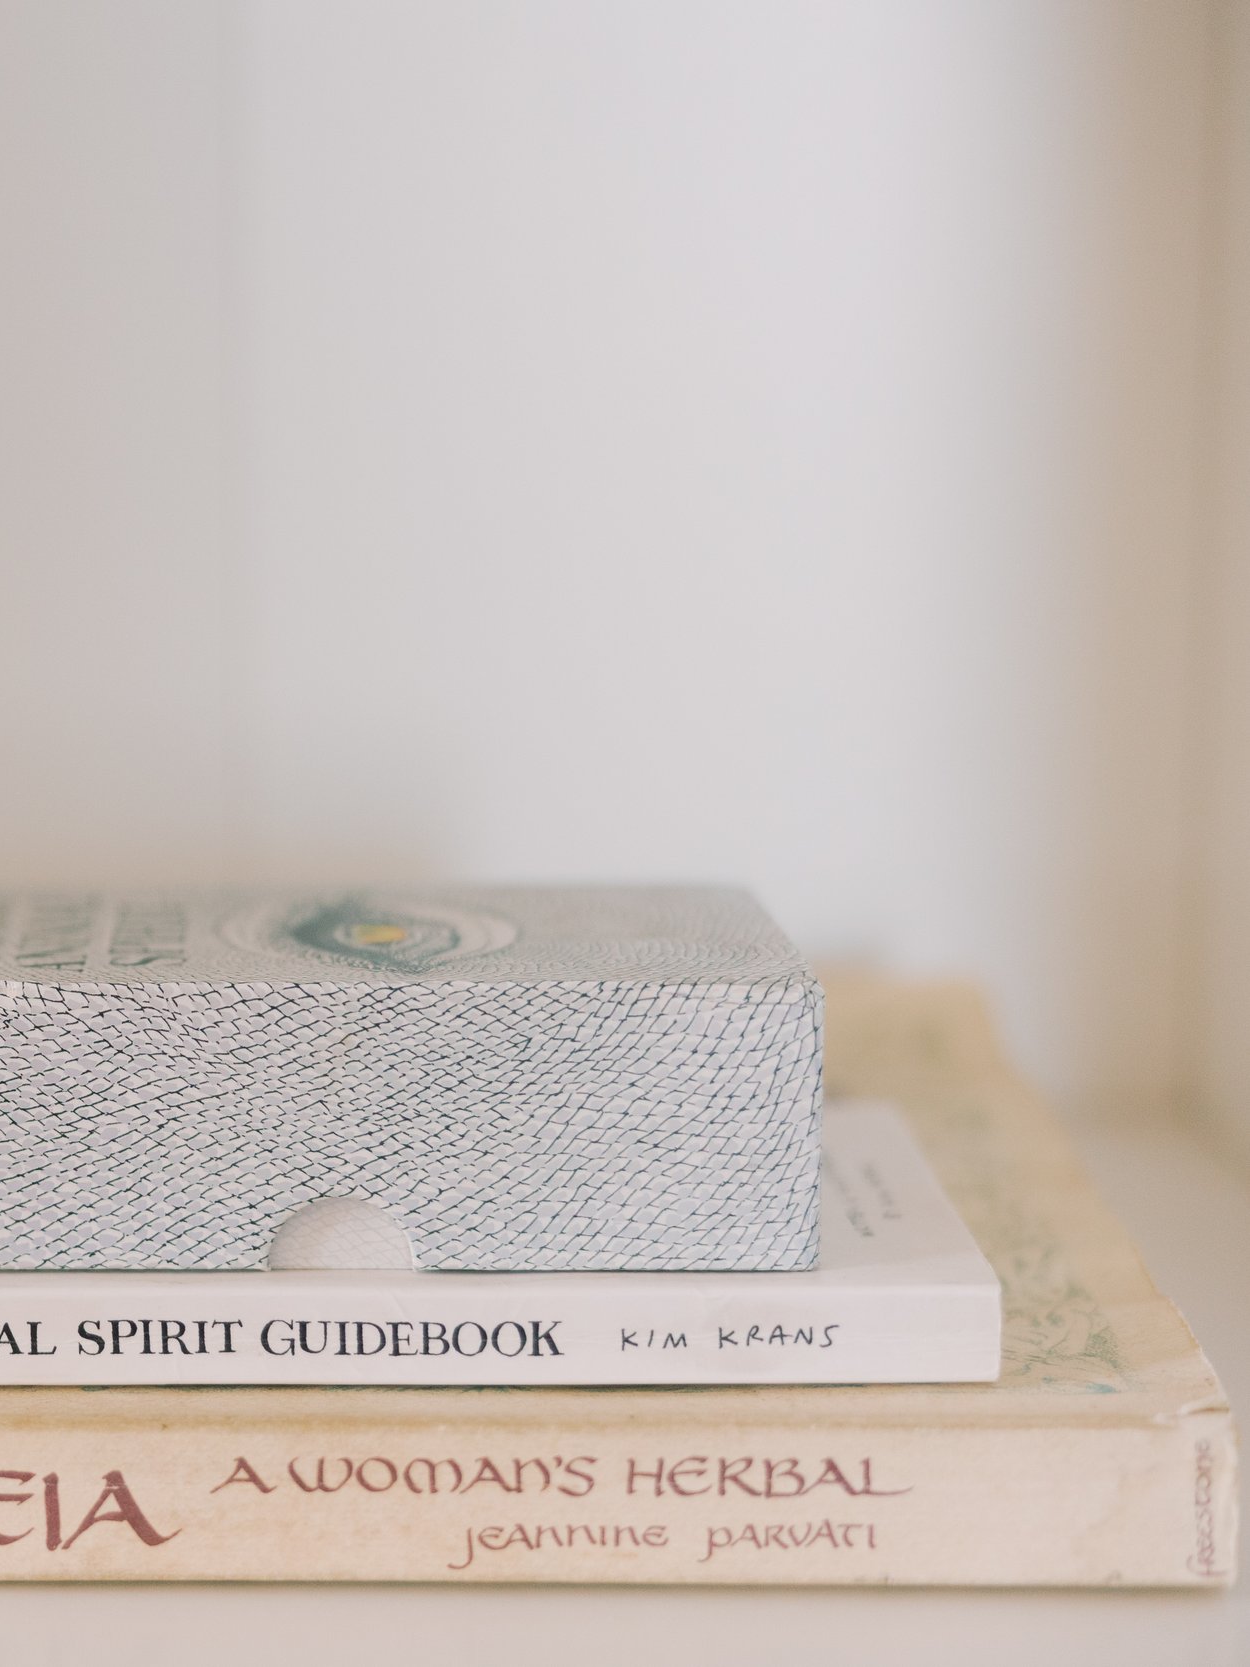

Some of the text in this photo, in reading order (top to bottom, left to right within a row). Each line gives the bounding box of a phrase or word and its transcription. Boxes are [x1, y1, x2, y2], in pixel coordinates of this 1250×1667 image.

[76, 1318, 244, 1357] SPIRIT
[259, 1318, 566, 1358] GUIDEBOOK
[620, 1323, 841, 1352] KIM KRANS
[209, 1455, 278, 1495] A
[625, 1455, 914, 1500] HERBAL
